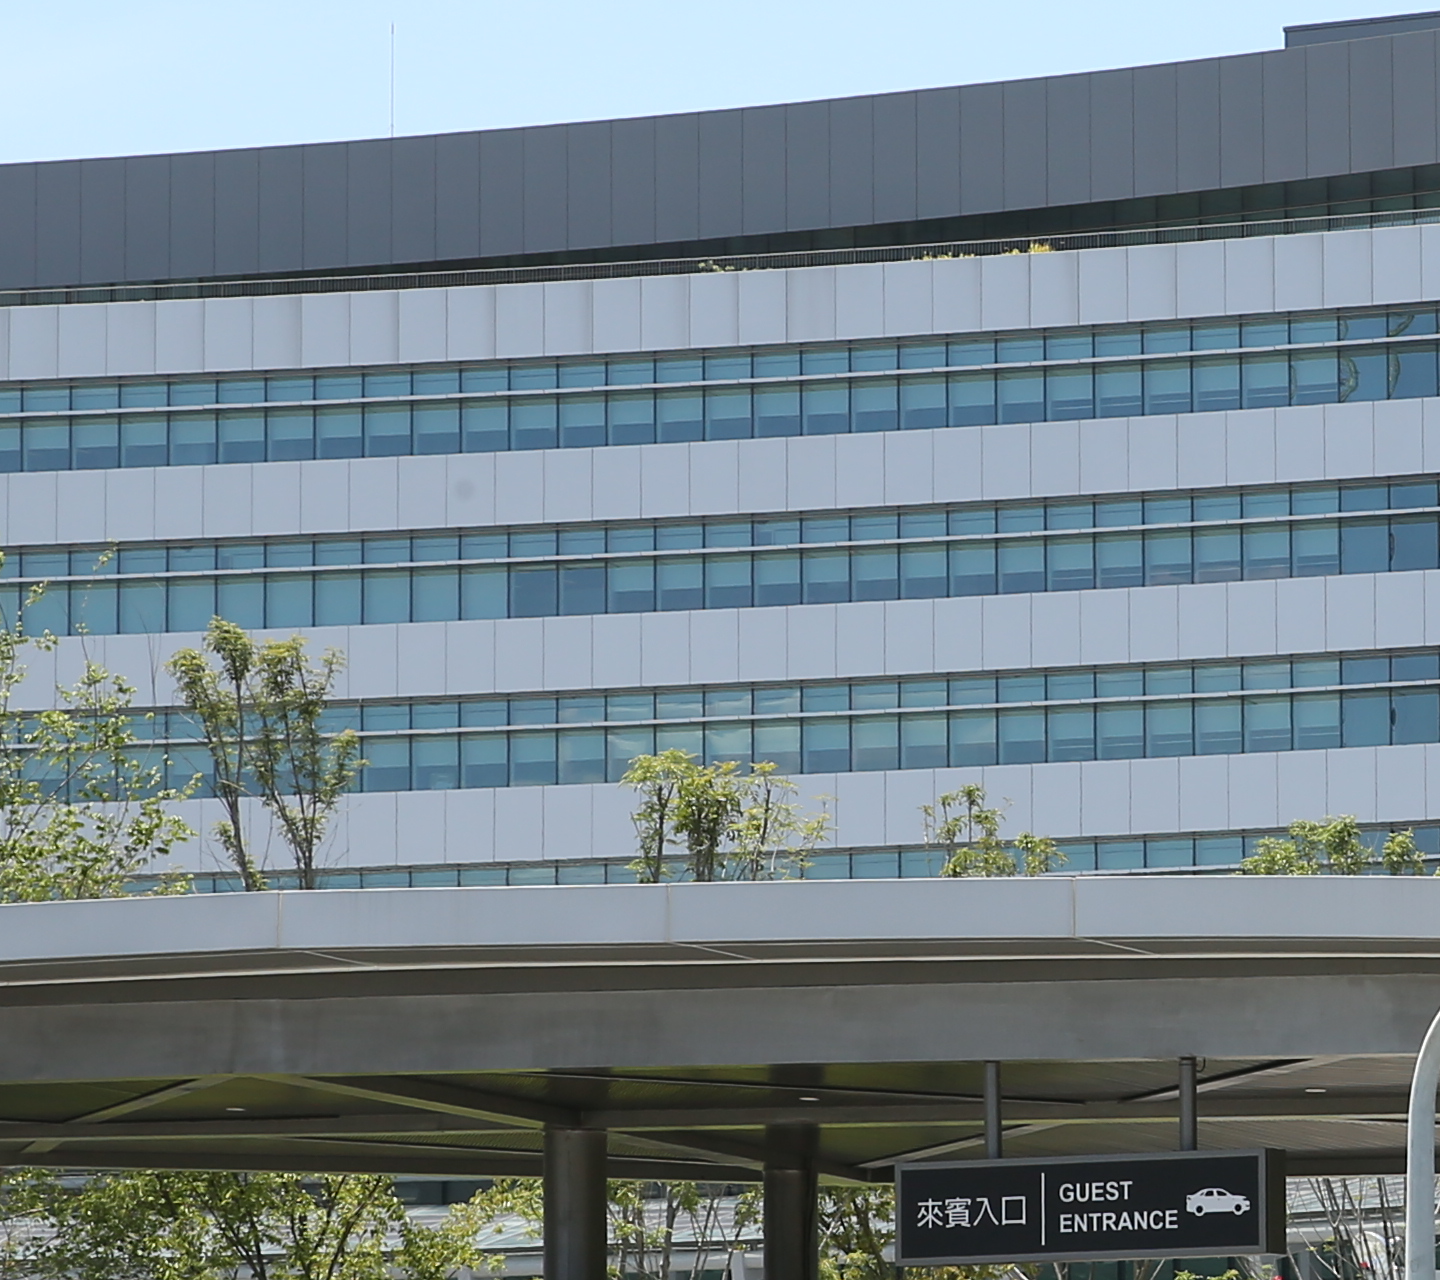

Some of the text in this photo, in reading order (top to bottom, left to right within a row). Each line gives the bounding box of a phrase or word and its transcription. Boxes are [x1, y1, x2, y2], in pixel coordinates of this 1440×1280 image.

[1058, 1181, 1133, 1204] GUEST
[916, 1195, 1027, 1229] 來賓入口
[1059, 1209, 1179, 1233] ENTRANCE
